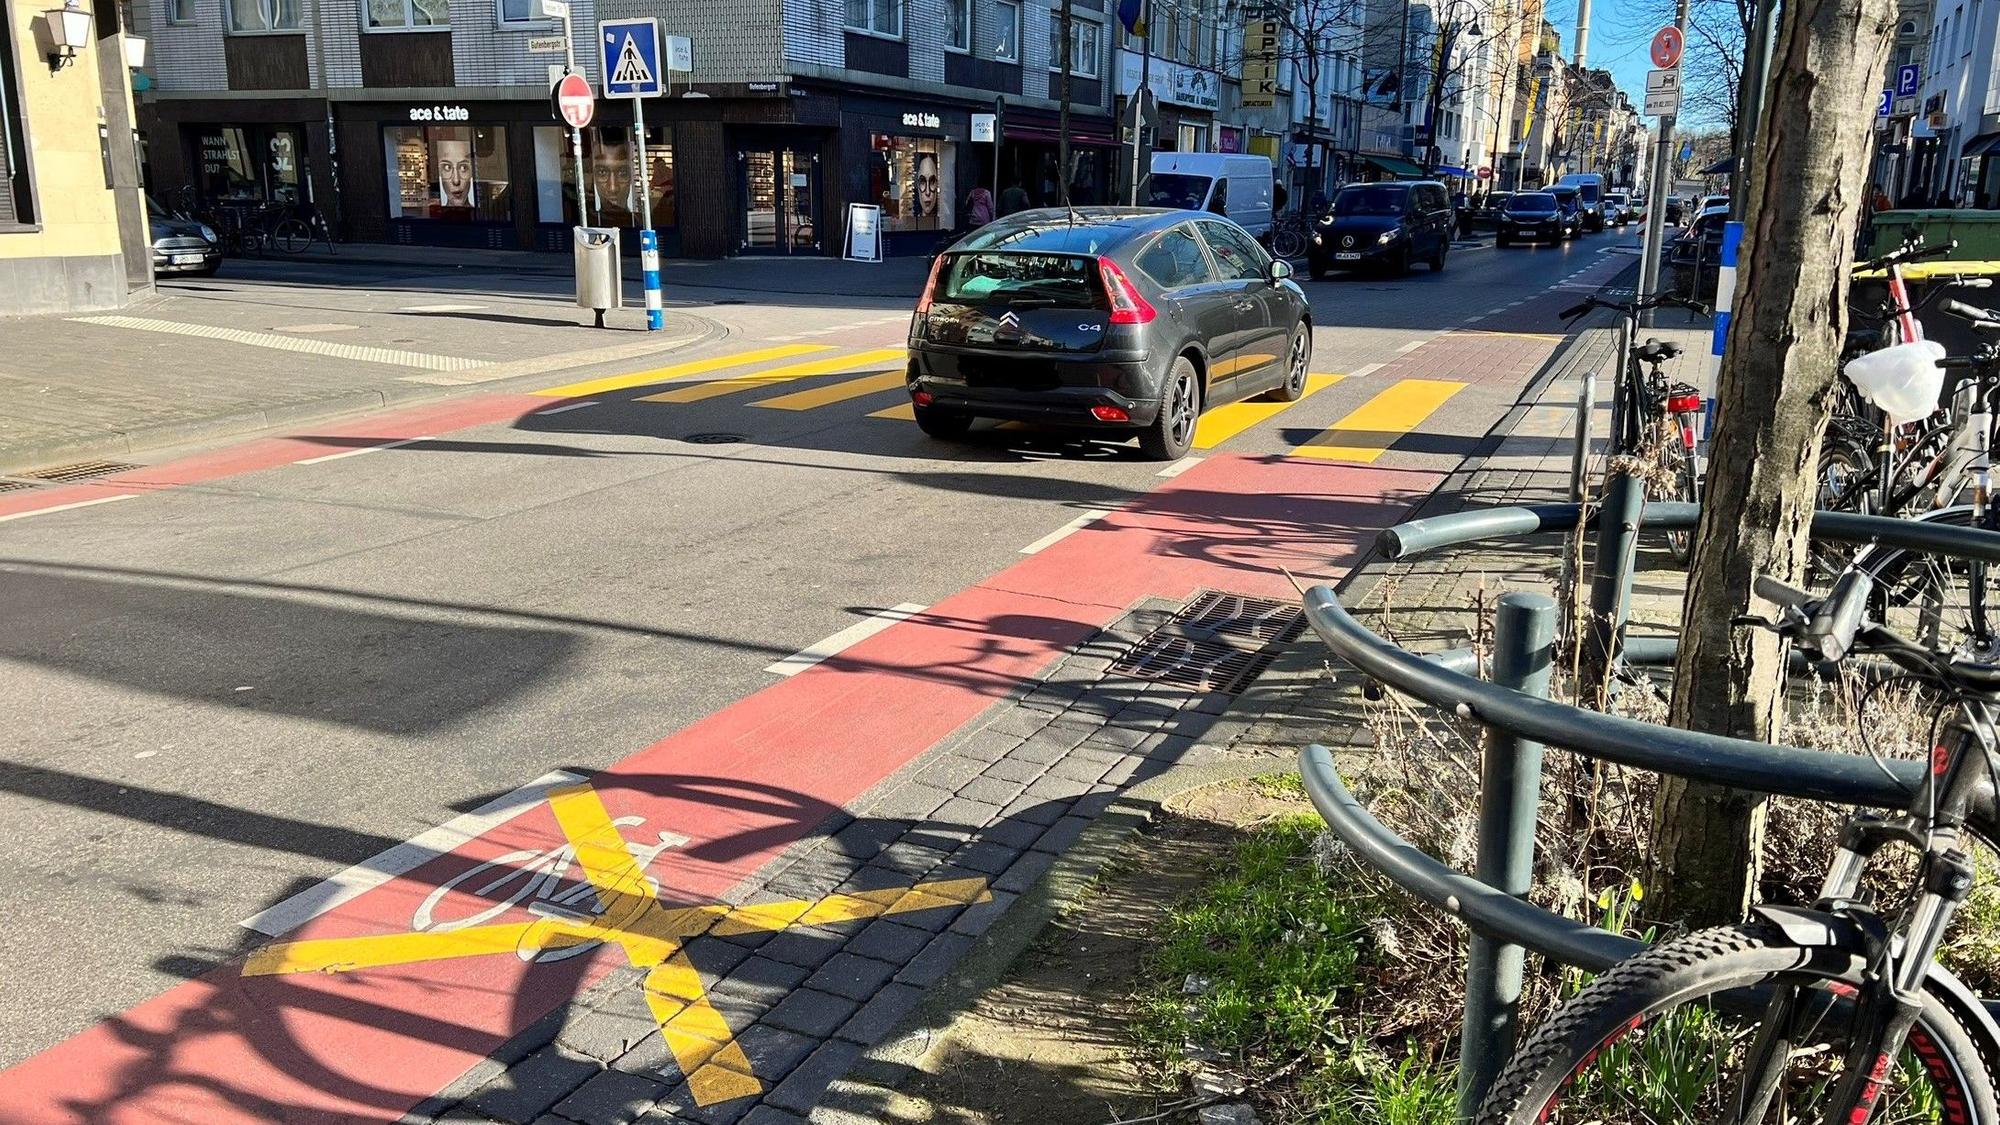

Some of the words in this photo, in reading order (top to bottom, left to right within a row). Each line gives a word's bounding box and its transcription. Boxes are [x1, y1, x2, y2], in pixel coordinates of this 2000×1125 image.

[1260, 23, 1276, 92] OPTIK
[409, 108, 432, 121] ace
[433, 105, 443, 121] &
[443, 105, 469, 121] tate
[902, 113, 917, 126] ace
[918, 112, 924, 127] &
[924, 112, 940, 129] tate
[202, 136, 226, 145] WANN
[203, 150, 240, 160] STRAHLST
[1077, 323, 1102, 332] C4
